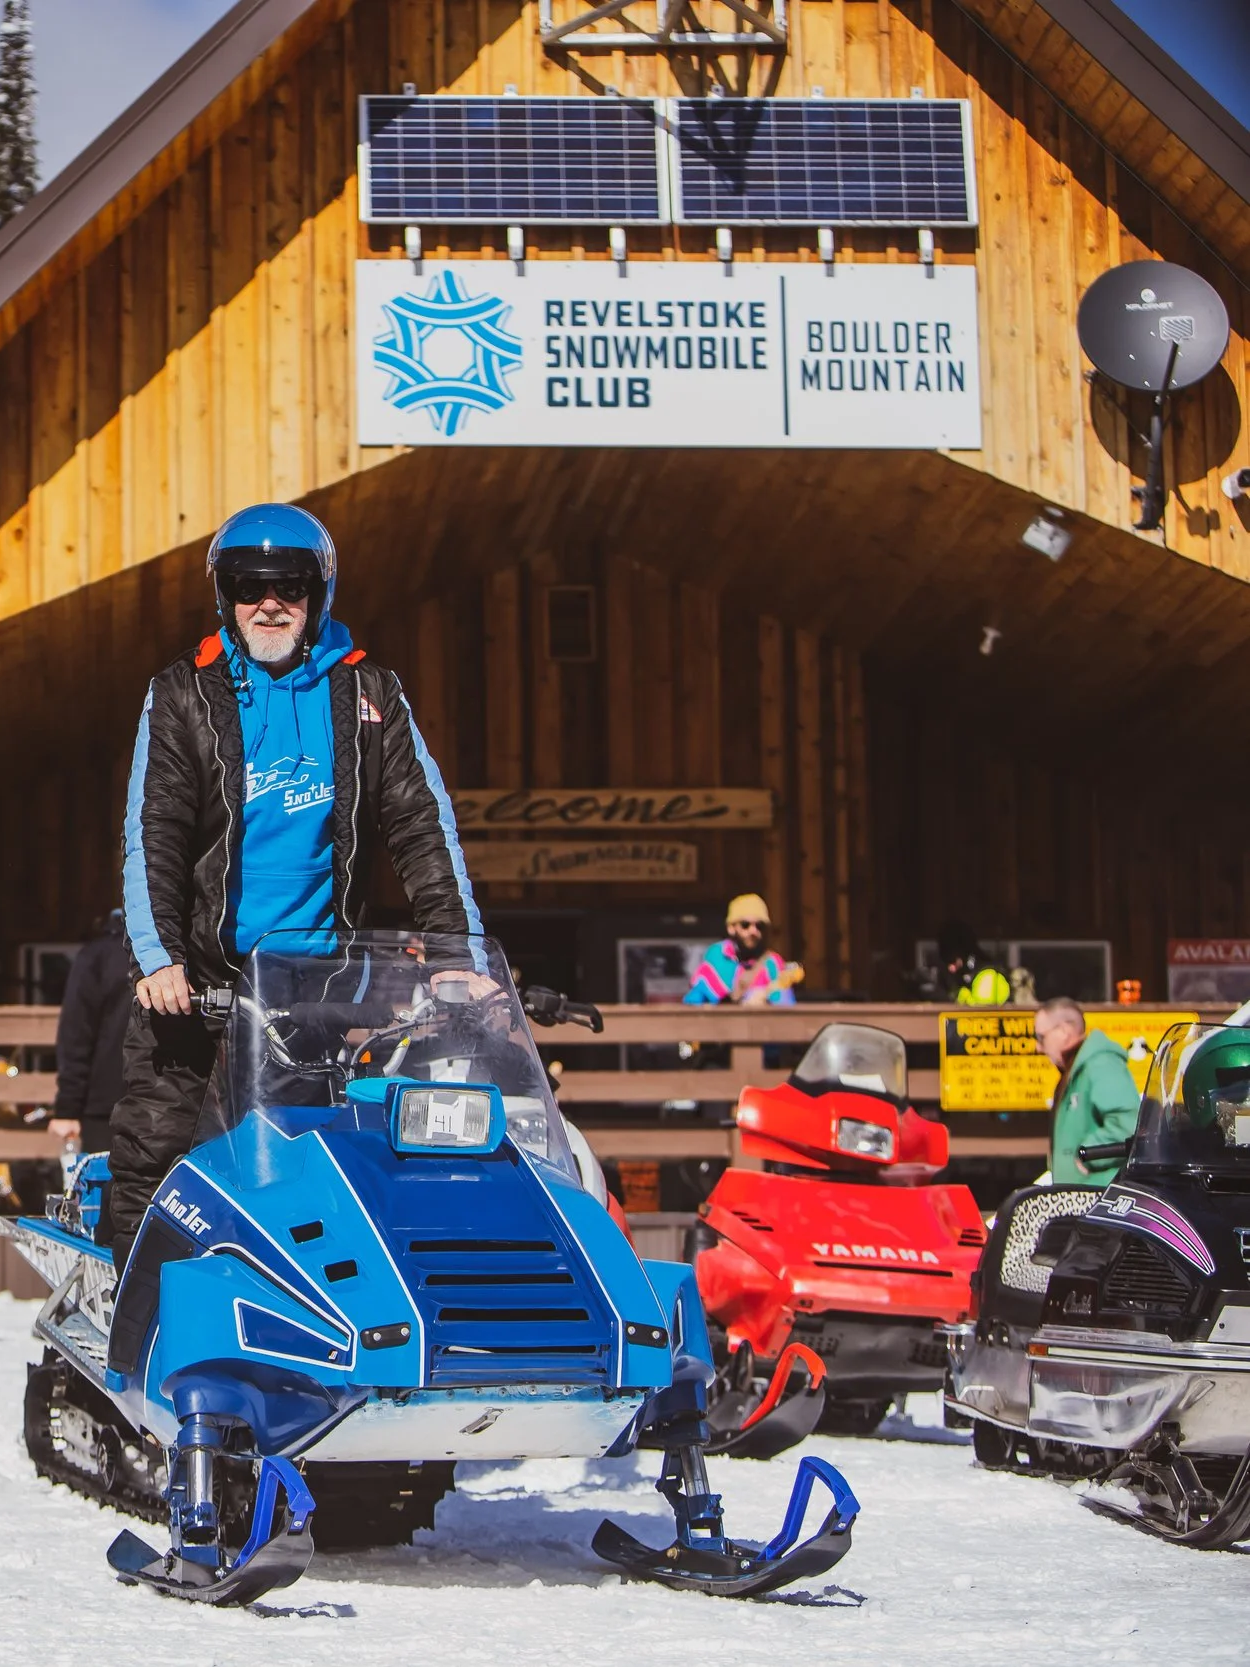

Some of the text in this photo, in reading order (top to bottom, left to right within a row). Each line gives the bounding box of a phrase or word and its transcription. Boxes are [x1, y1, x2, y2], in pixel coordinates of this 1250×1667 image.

[545, 300, 767, 328] REVELSTOKE
[545, 335, 768, 369] SNOWMOBILE
[808, 320, 952, 354] BOULDER
[801, 359, 966, 392] MOUNTAIN
[546, 376, 651, 408] CLUB
[434, 1115, 452, 1132] 41
[811, 1242, 940, 1264] YAMAHA
